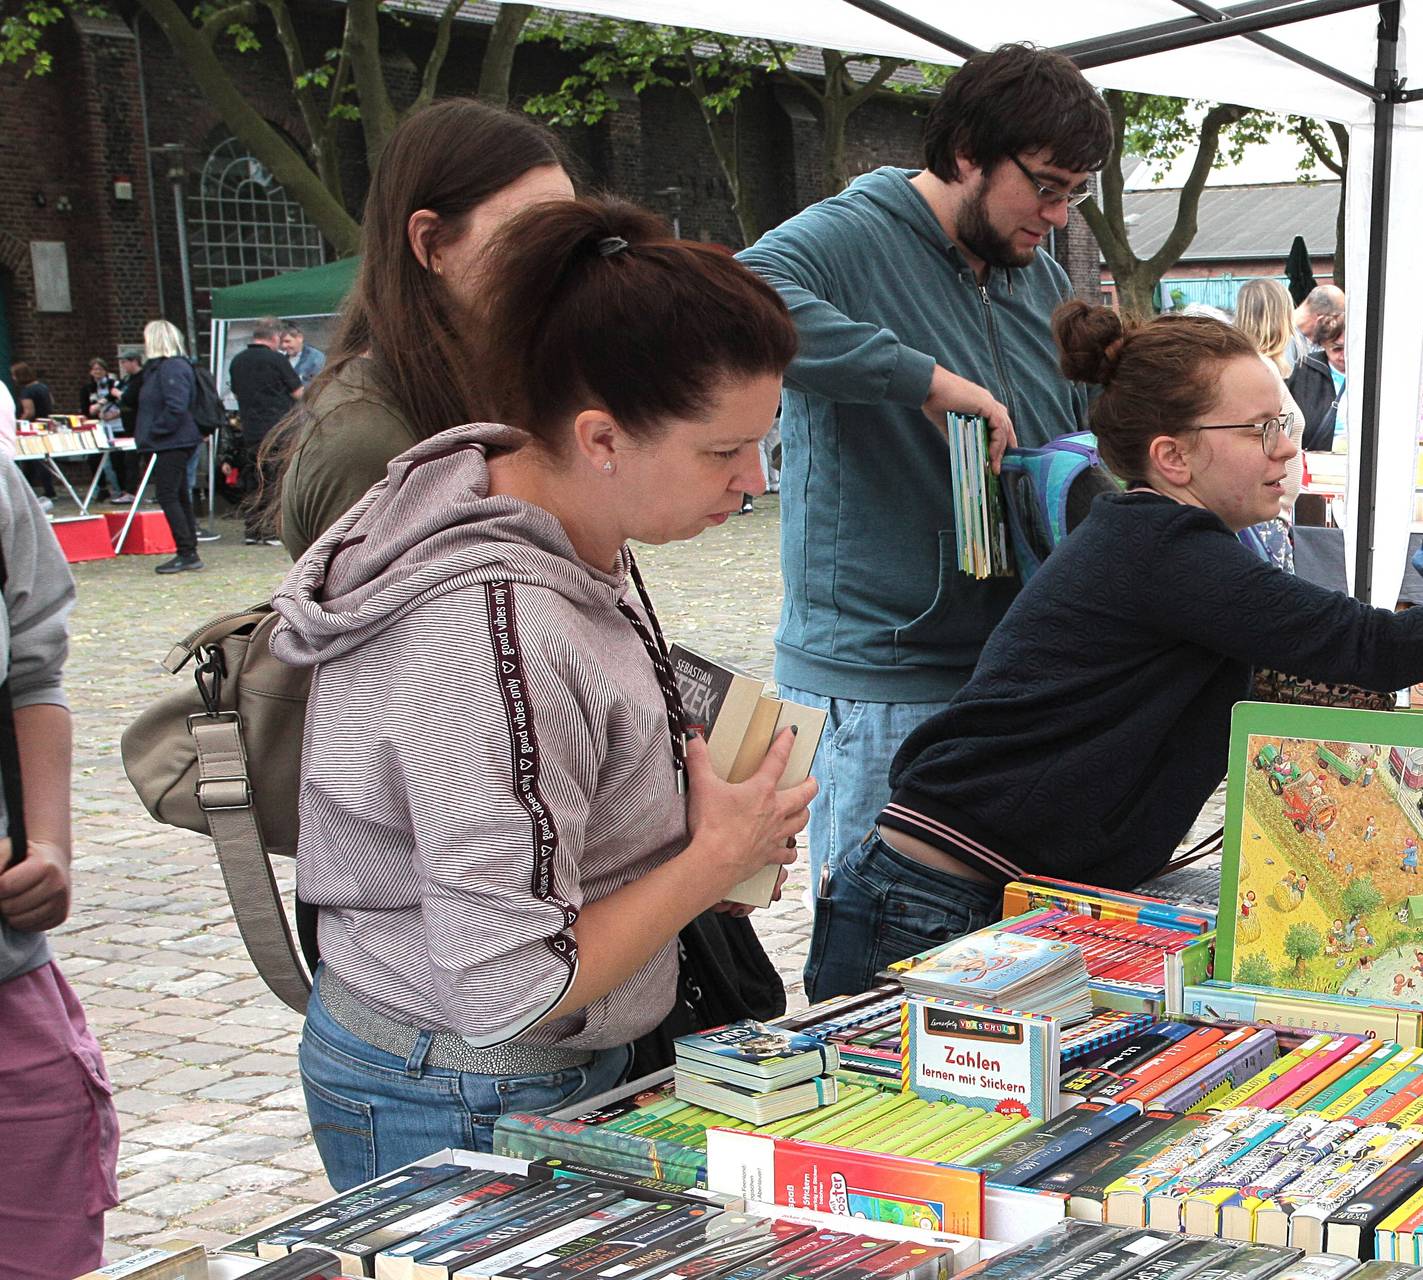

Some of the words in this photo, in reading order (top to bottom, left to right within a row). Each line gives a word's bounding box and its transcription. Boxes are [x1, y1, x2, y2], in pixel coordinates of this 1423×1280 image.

[491, 588, 508, 604] only
[494, 606, 507, 631] vibes
[496, 632, 515, 656] good
[675, 658, 714, 686] SEBASTIAN
[506, 678, 521, 700] only
[675, 673, 719, 722] TZEK
[513, 700, 526, 729] vibes
[516, 730, 534, 754] good
[525, 792, 545, 819] vibes
[537, 817, 555, 841] good
[544, 895, 570, 908] good
[705, 1028, 751, 1043] QUIZ
[930, 1018, 958, 1030] Lernerfolg
[959, 1019, 1016, 1035] VORSCHULE
[944, 1045, 1001, 1072] Zahlen
[922, 1064, 955, 1082] lernen
[959, 1074, 976, 1086] mit
[980, 1076, 1026, 1094] Stickern
[566, 1163, 609, 1178] KLAUS-PETER
[608, 1172, 630, 1181] WOLF
[802, 1172, 811, 1205] Stickern
[335, 1197, 378, 1215] KLIFF
[374, 1203, 412, 1219] OHNE
[326, 1218, 377, 1240] AUSWEG
[631, 1232, 651, 1241] WOLF
[1081, 1252, 1119, 1262] NELE
[1141, 1260, 1182, 1271] DIE
